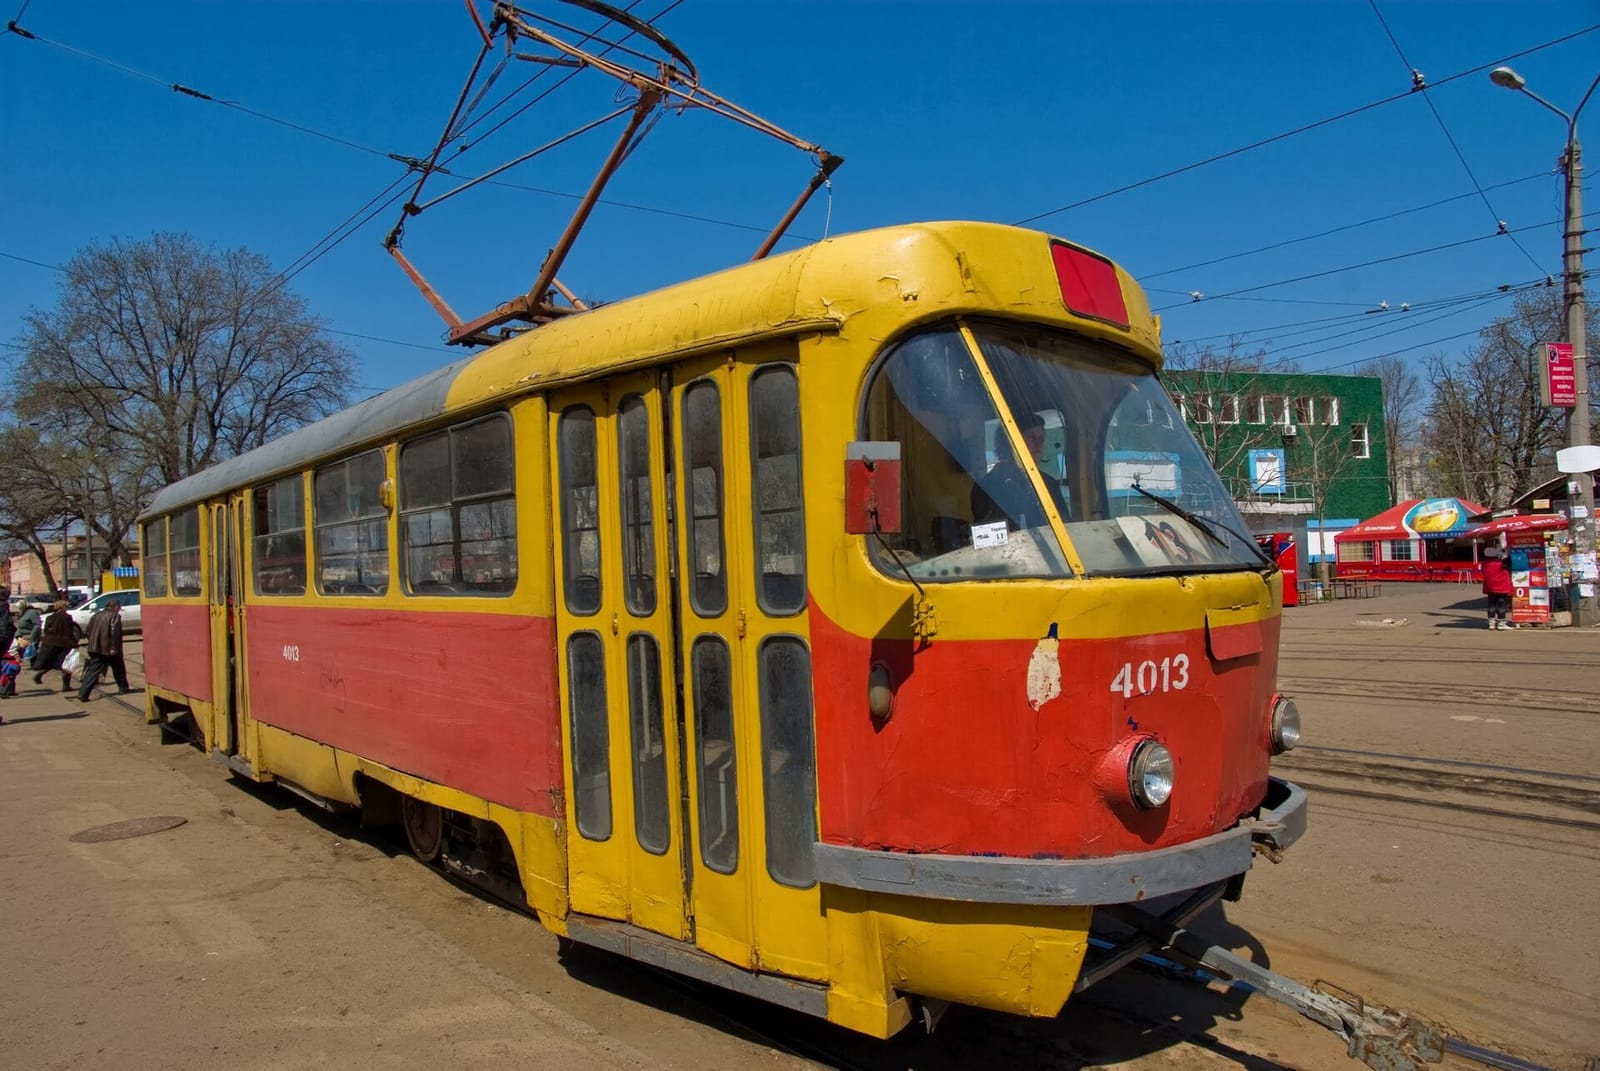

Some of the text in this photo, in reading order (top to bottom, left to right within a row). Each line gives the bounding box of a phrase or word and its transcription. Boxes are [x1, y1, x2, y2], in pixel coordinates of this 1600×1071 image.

[1144, 521, 1196, 563] 13
[283, 644, 299, 662] 4013
[1110, 653, 1190, 698] 4013
